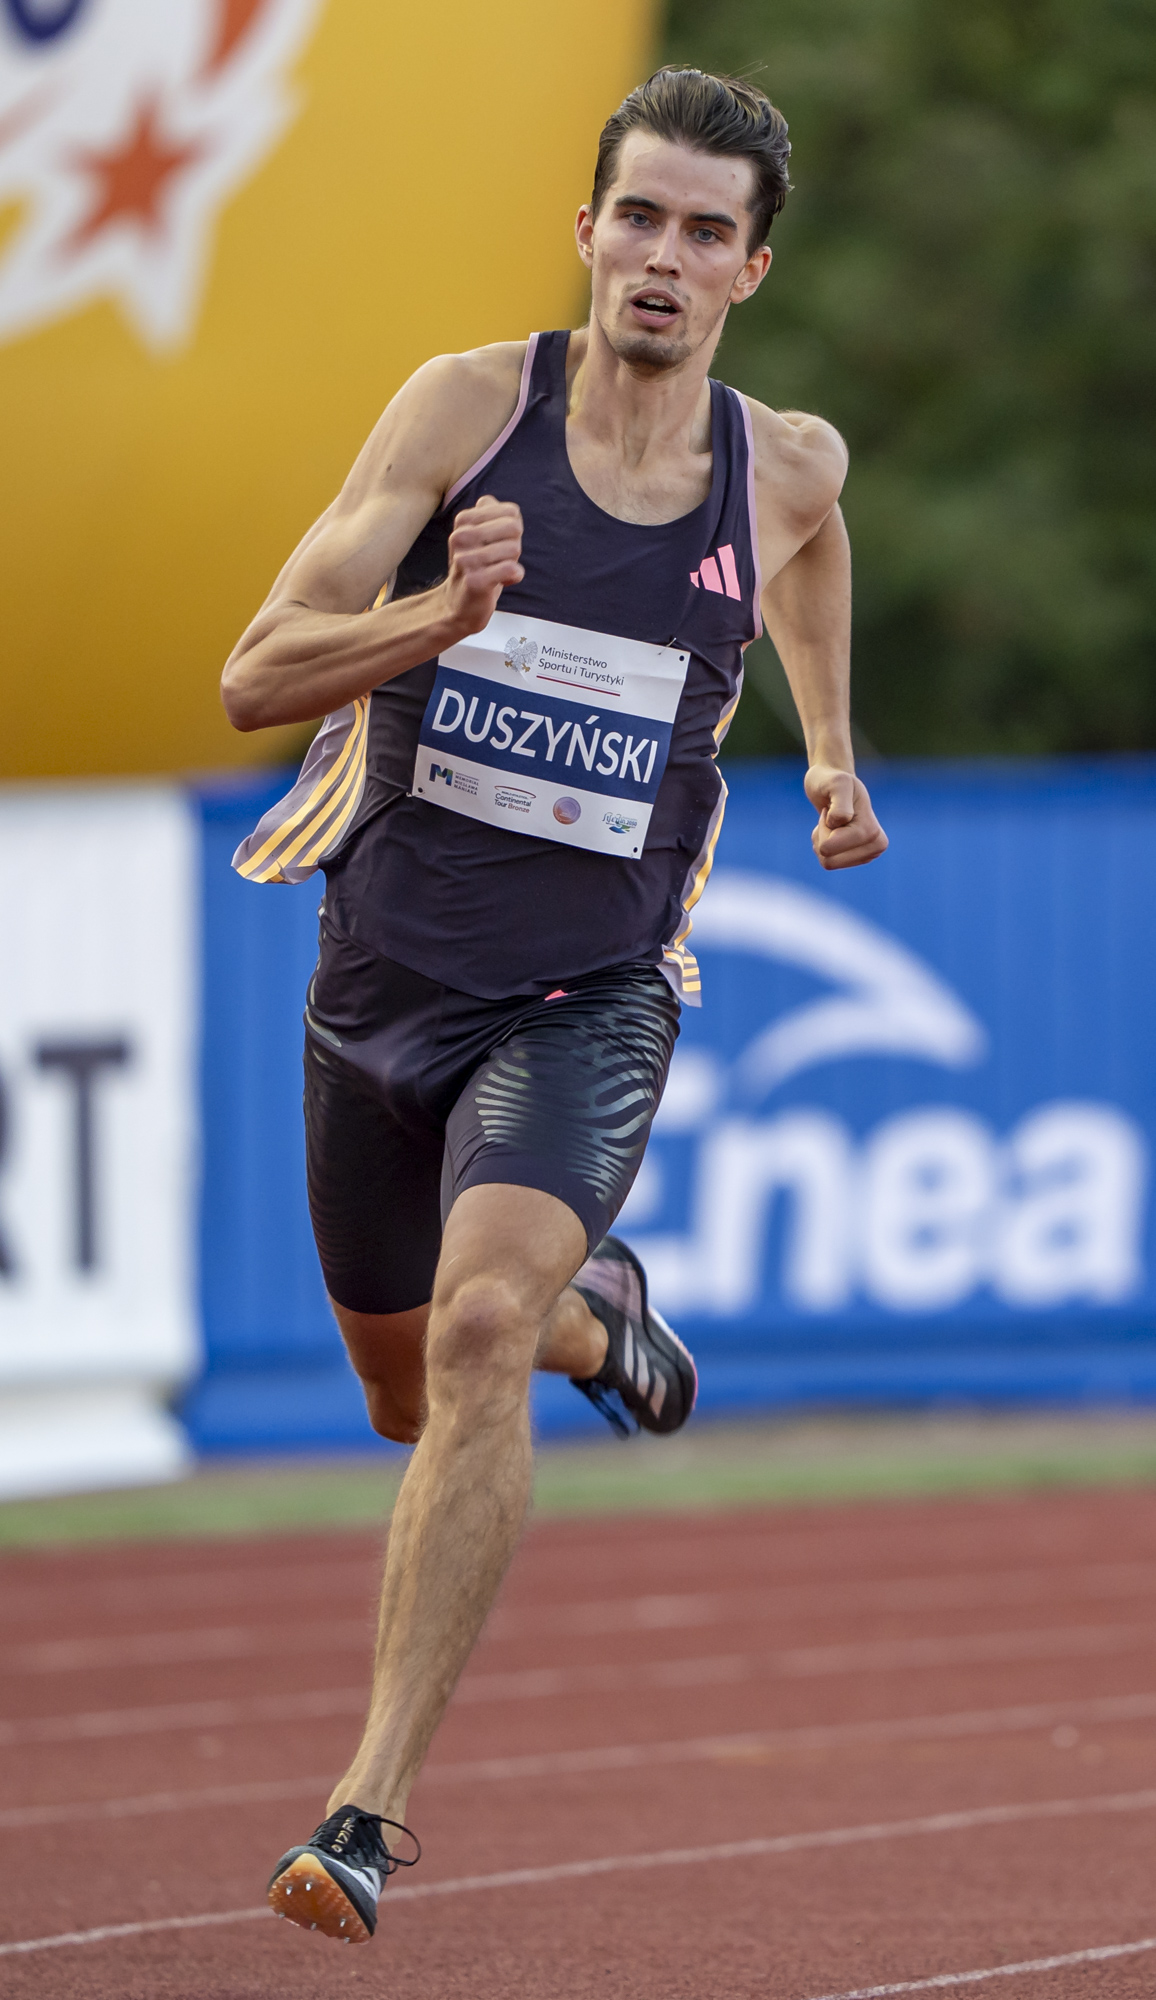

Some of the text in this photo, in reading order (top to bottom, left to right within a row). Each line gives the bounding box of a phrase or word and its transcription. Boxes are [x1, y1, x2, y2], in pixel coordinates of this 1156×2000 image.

[541, 645, 608, 669] Ministerstwo
[538, 658, 625, 686] Sportu i Turystyki
[431, 687, 658, 784] DUSZYŃSKI
[494, 798, 531, 814] Tour Bronze
[495, 792, 532, 807] Continental
